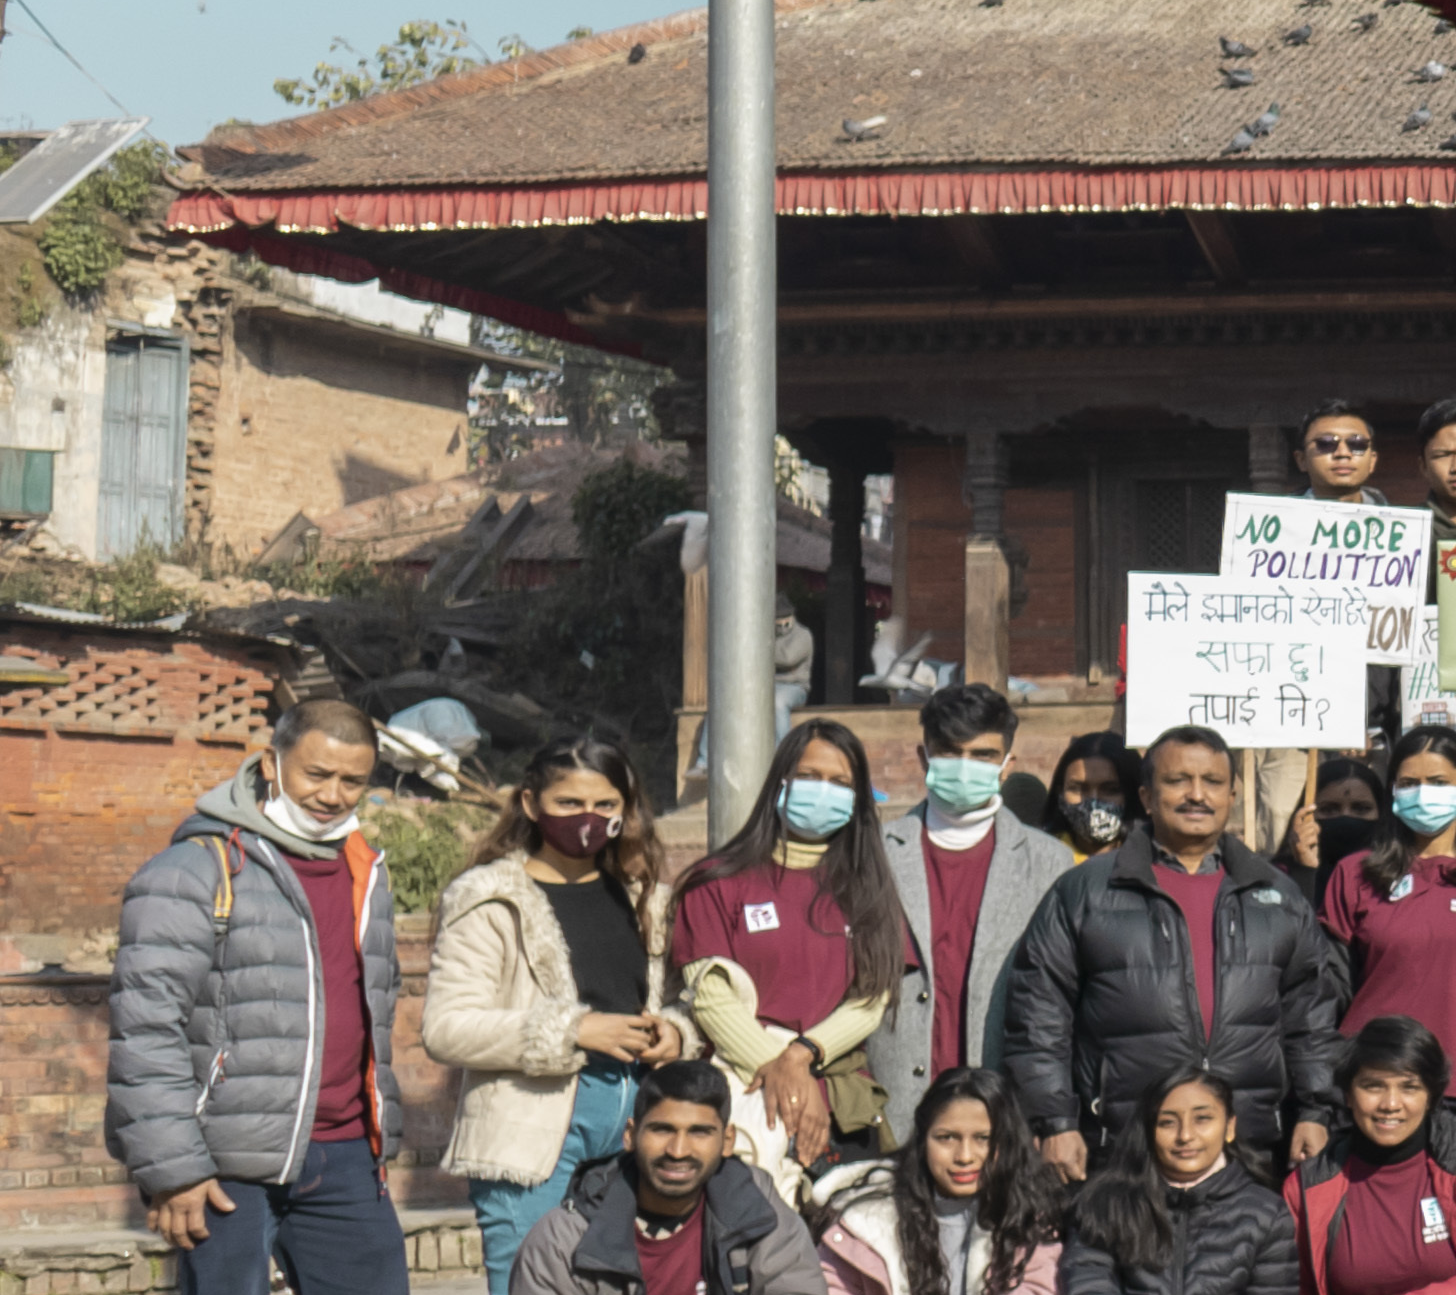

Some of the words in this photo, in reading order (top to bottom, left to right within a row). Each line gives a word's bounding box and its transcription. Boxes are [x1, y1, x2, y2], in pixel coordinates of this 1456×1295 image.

[1236, 514, 1281, 544] NO
[1311, 517, 1407, 552] MORE
[1248, 549, 1421, 587] POLLUTION
